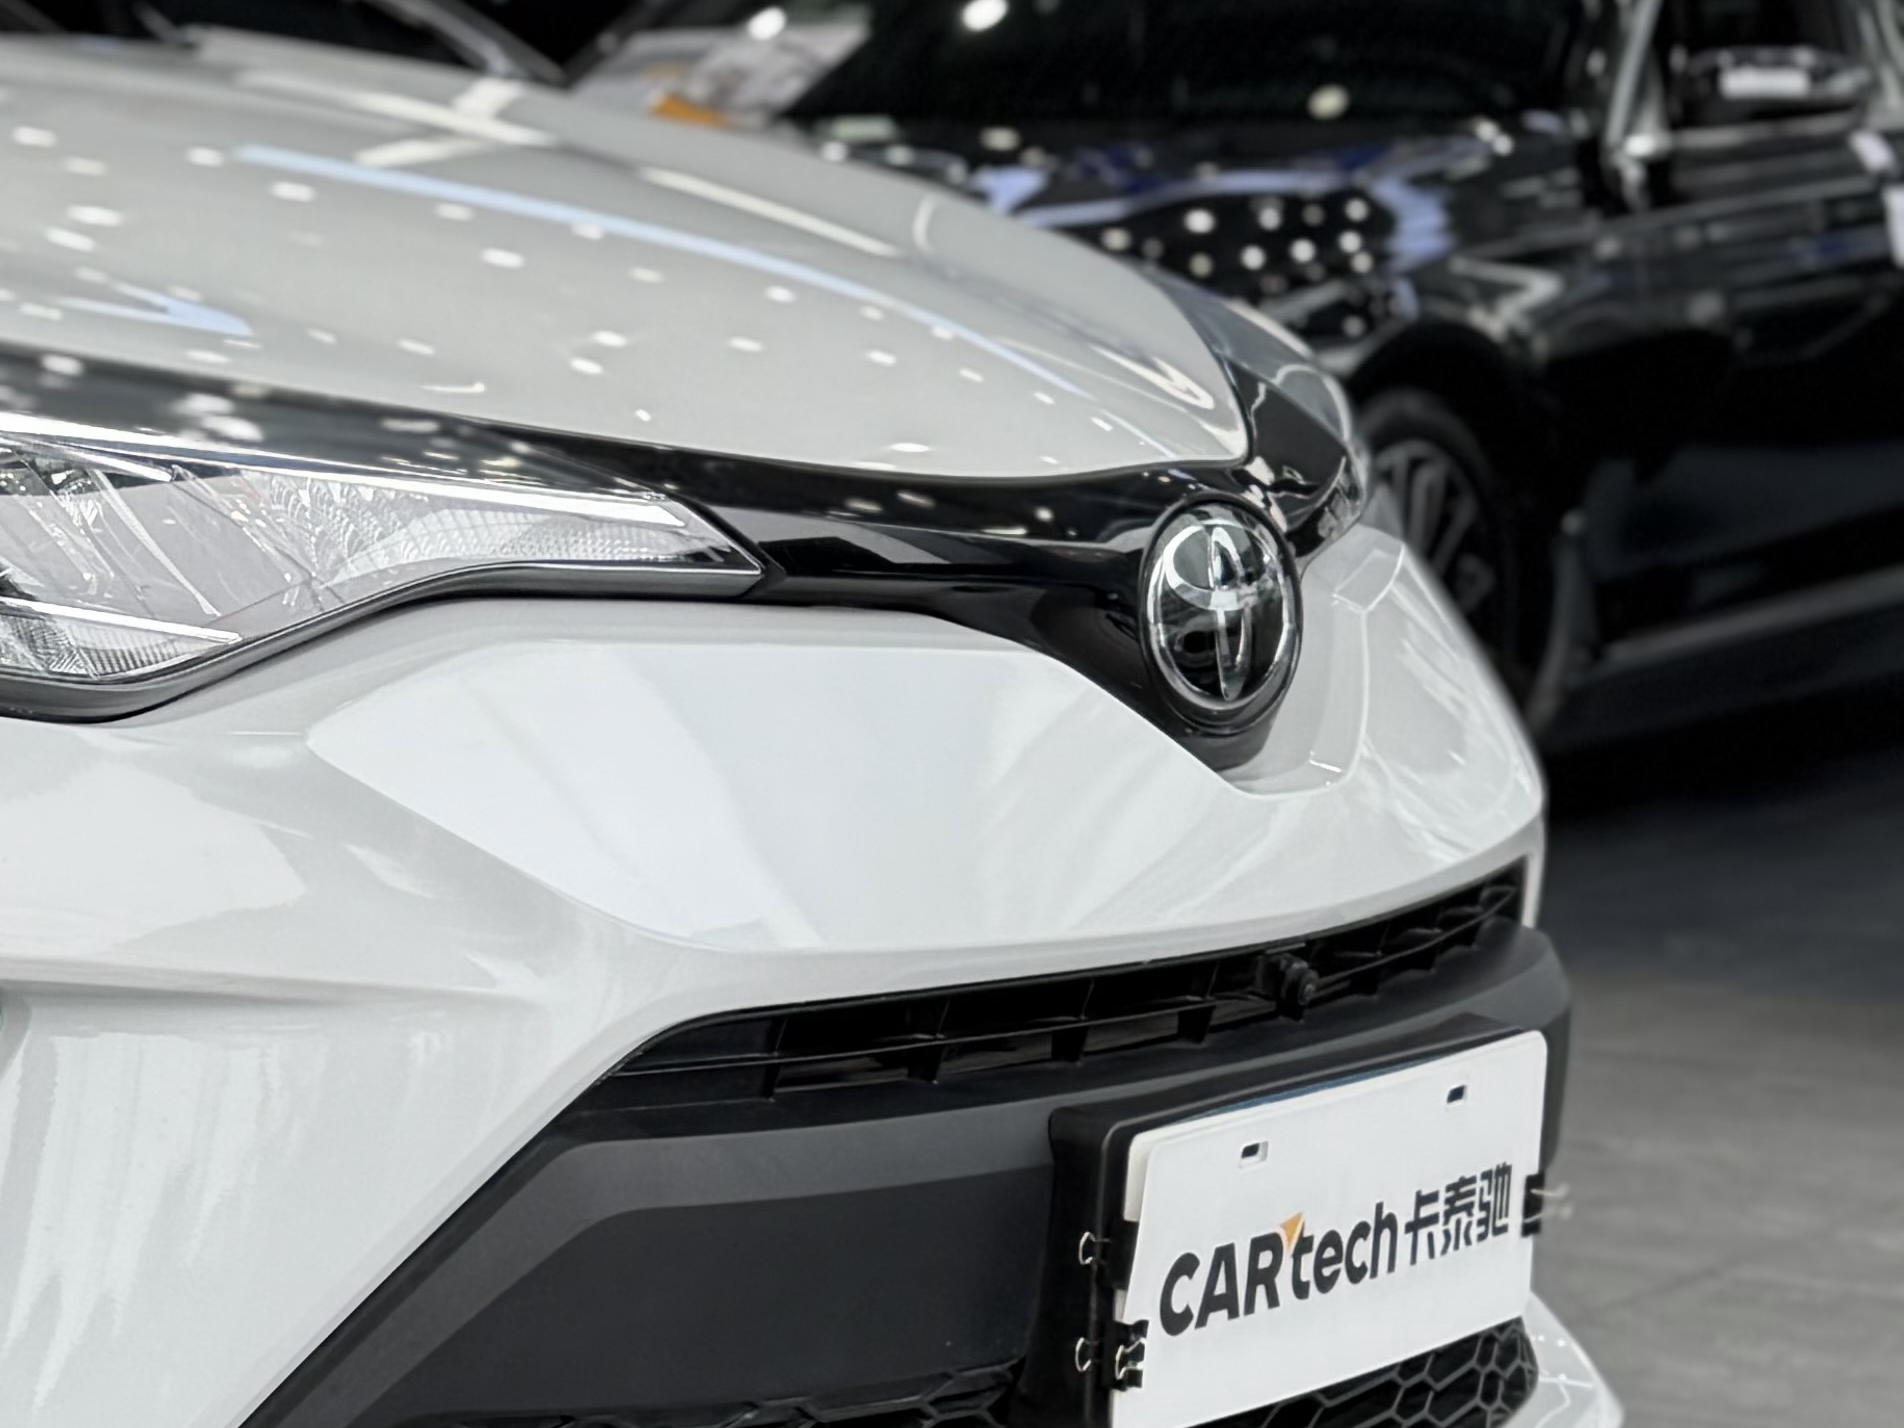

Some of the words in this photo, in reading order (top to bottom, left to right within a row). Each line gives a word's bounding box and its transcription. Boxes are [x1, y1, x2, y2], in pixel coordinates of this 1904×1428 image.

[1159, 1200, 1398, 1336] CARtech
[1404, 1161, 1513, 1266] 卡泰驰
